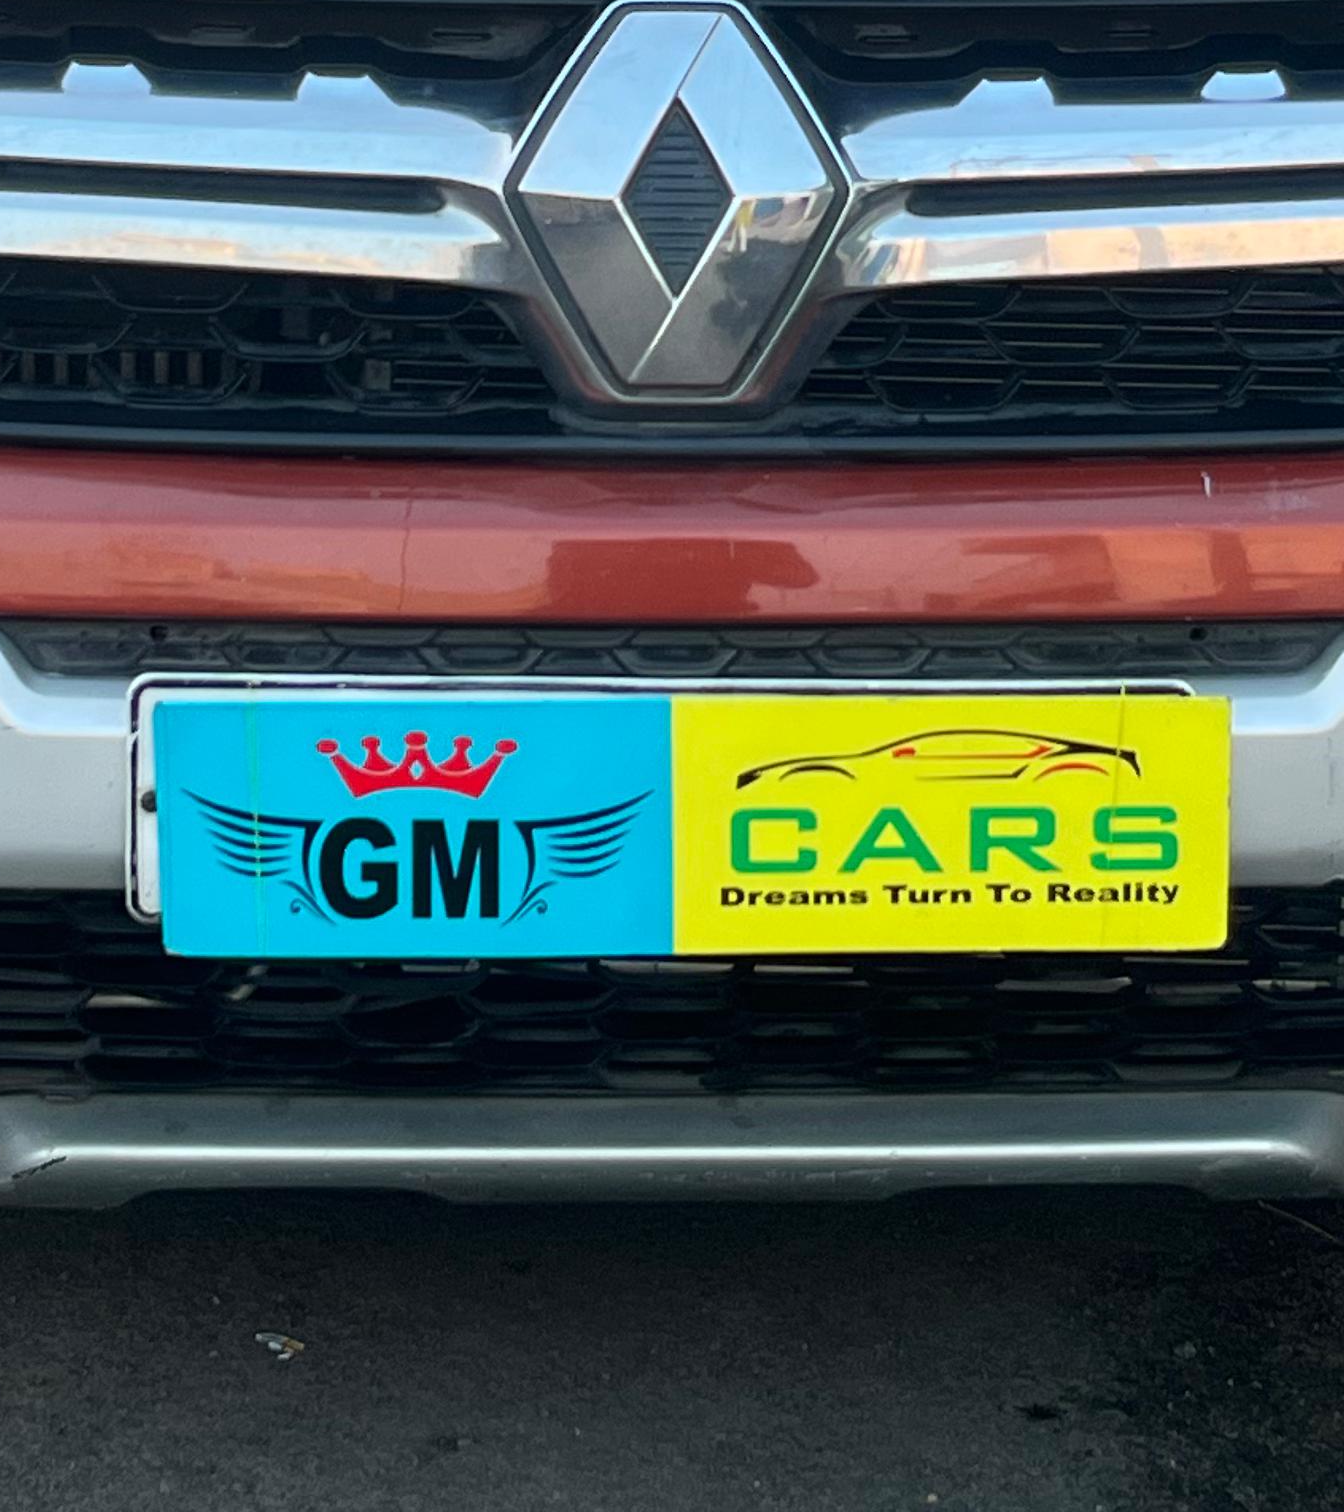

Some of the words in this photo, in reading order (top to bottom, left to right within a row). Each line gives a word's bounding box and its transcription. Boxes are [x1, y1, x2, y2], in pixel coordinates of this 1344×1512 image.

[319, 816, 501, 920] GM
[730, 805, 1180, 874] CARS
[719, 886, 869, 907] Dreams
[882, 884, 972, 905] Turn
[985, 883, 1033, 904] To
[1047, 881, 1180, 905] Reality
